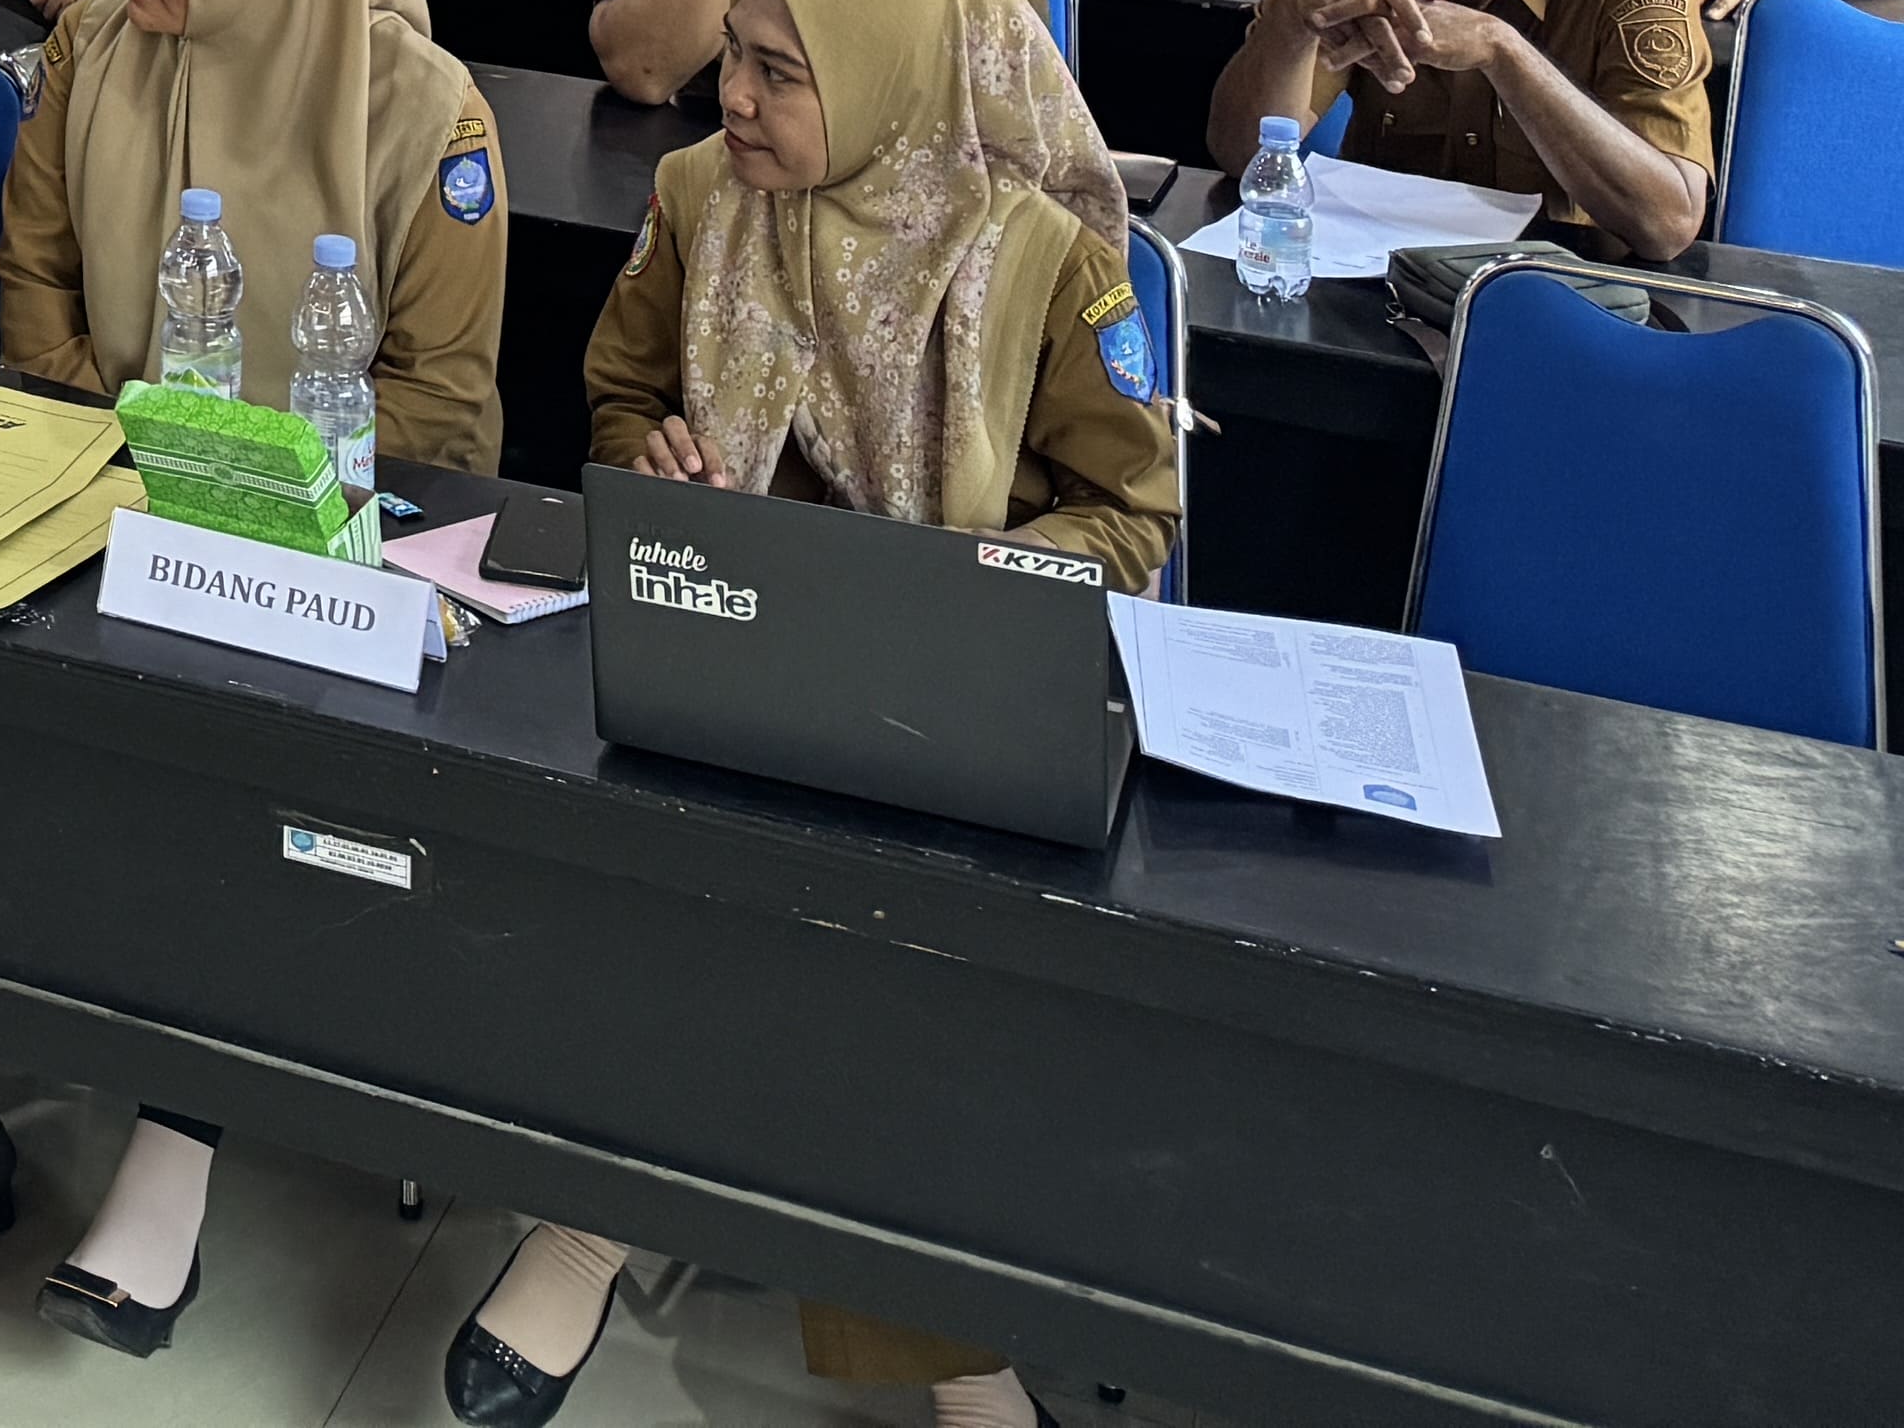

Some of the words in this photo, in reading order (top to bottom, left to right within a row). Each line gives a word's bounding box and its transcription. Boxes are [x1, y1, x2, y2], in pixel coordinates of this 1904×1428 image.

[630, 537, 708, 571] inhale
[148, 554, 276, 609] BIDANG
[285, 587, 376, 632] PAUD
